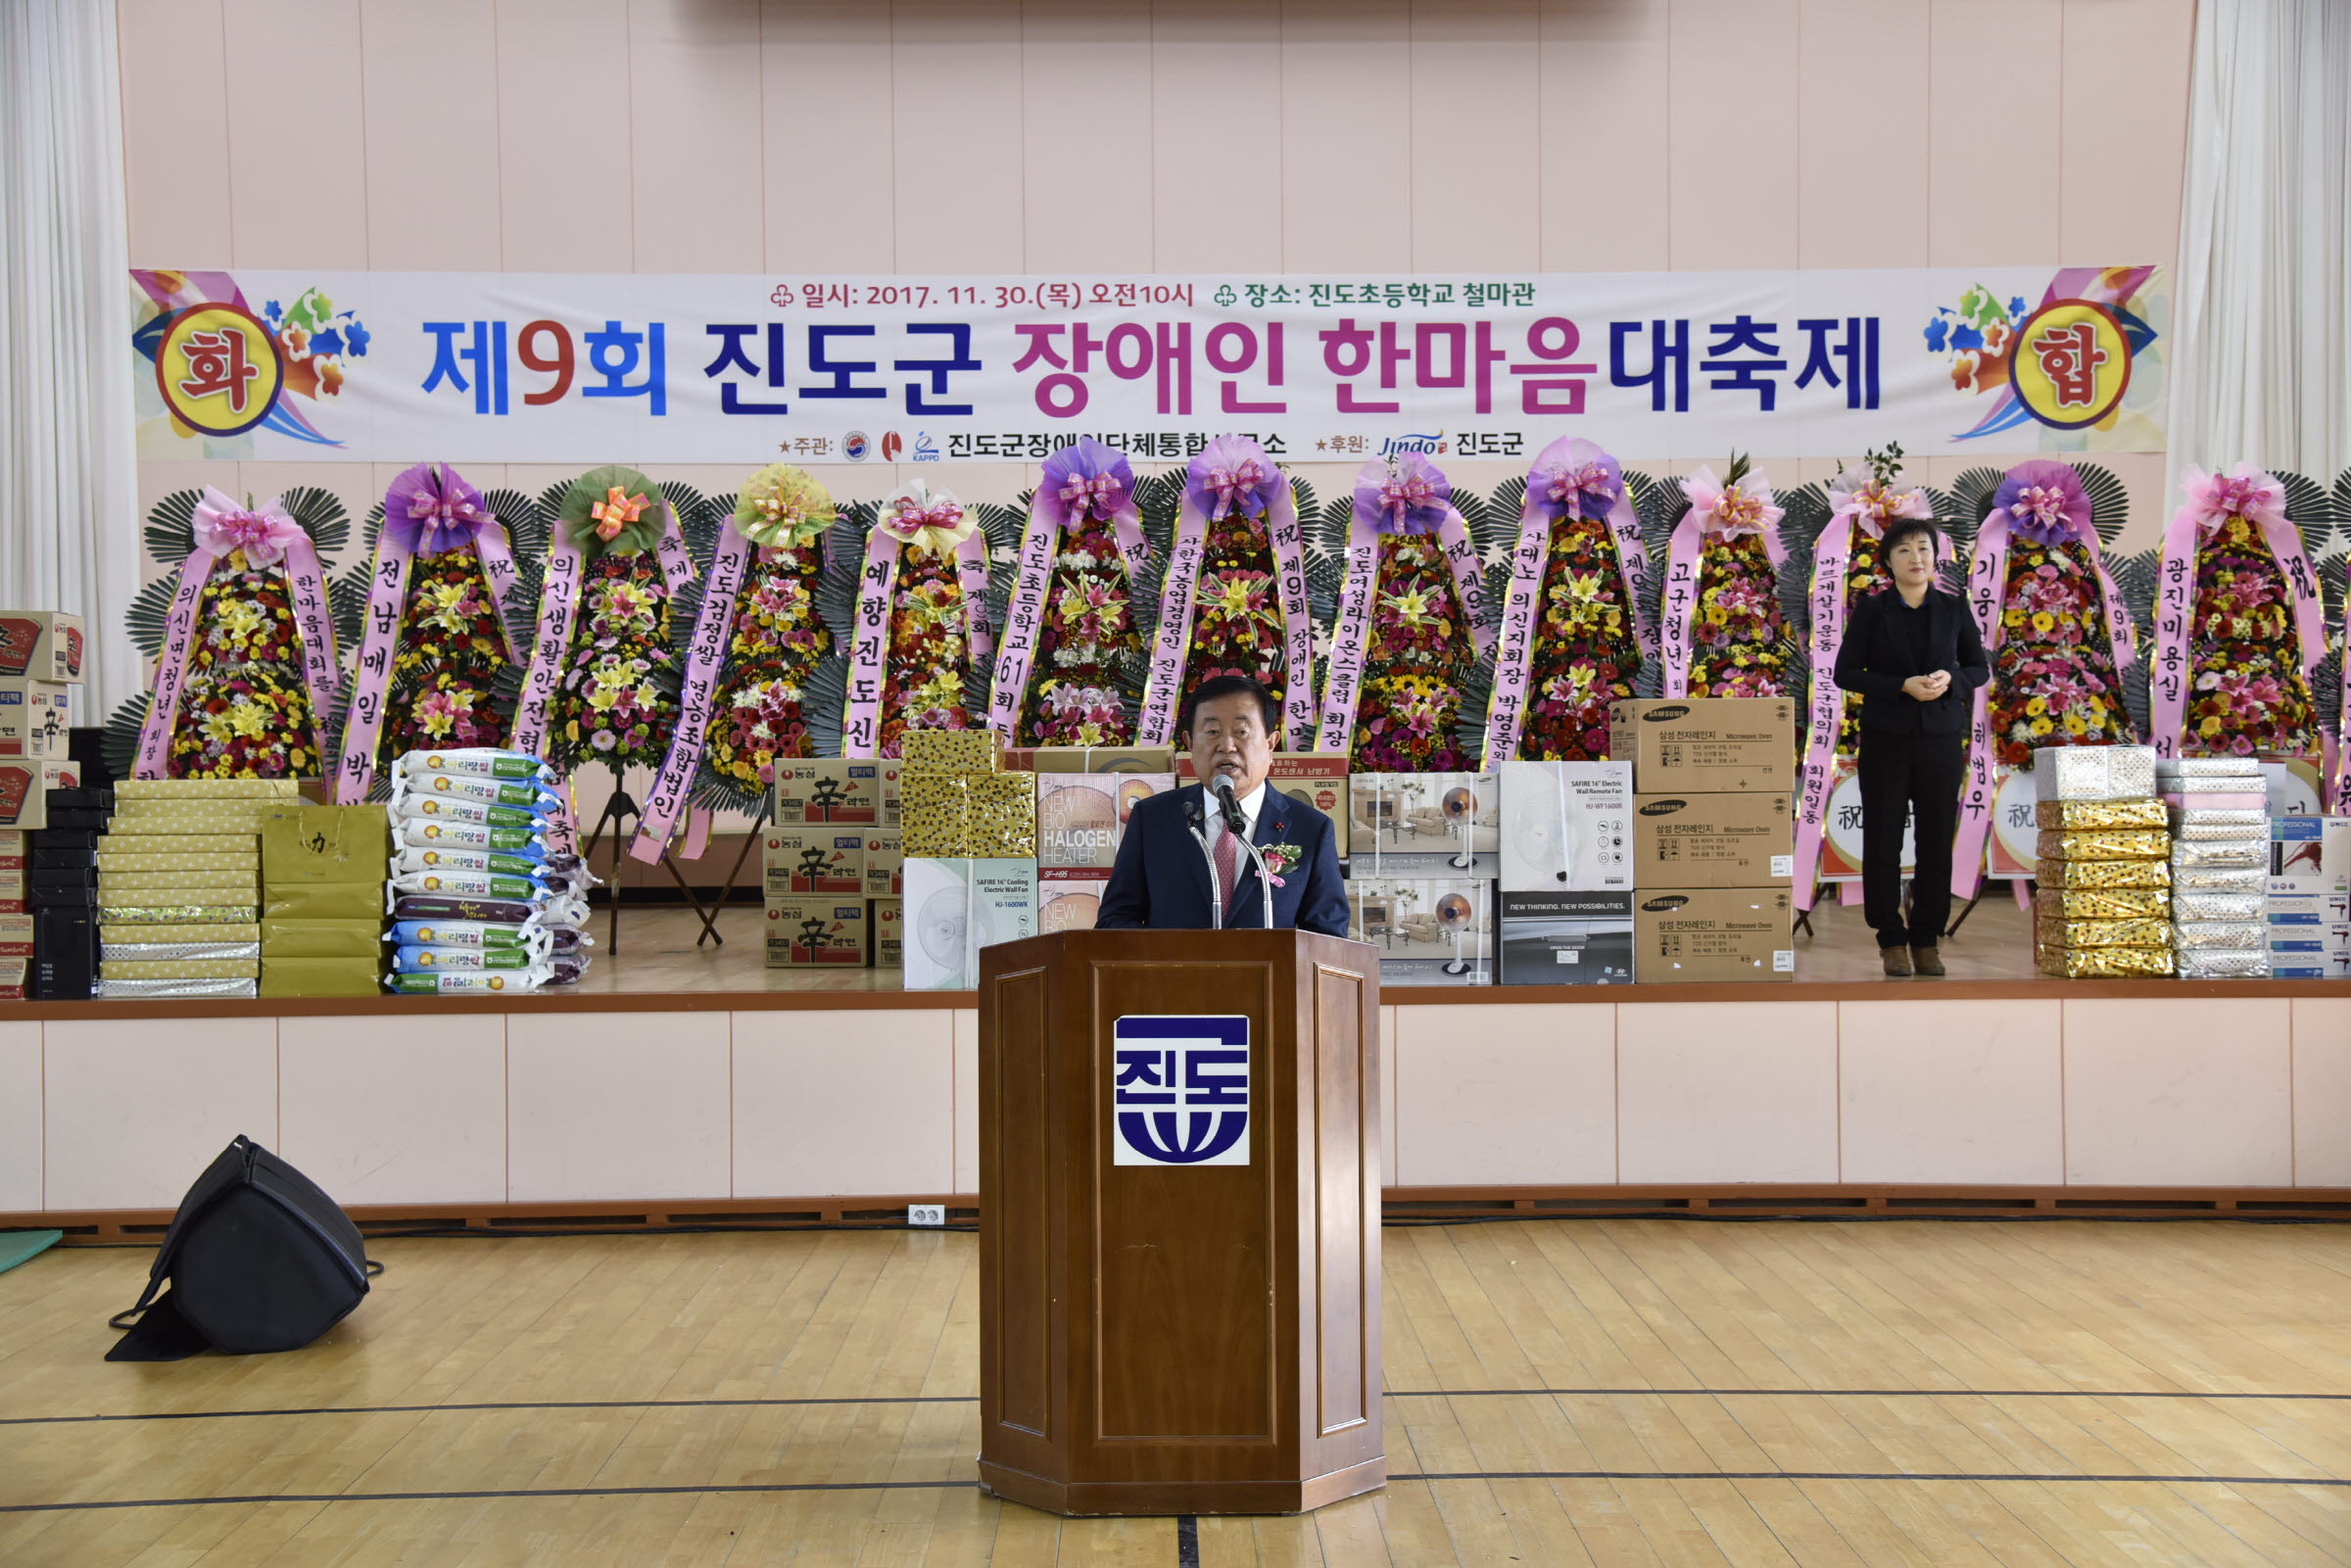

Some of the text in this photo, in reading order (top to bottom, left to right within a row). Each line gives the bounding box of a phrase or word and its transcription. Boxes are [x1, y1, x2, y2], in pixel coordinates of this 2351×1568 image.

[801, 284, 858, 309] 일시:
[866, 286, 938, 307] 2017.
[947, 286, 985, 306] 11.
[1089, 283, 1193, 309] 오전10시
[1244, 282, 1536, 309] 장소: 진도초등학교 철마관
[179, 328, 259, 412] 화
[421, 313, 1881, 419] 제9회 진도군 장애인 한마음 대축제
[2034, 323, 2108, 408] 합
[793, 437, 834, 455] 주관:
[1330, 435, 1369, 453] 후원:
[1457, 432, 1524, 455] 진도군
[1275, 524, 1300, 547] 祝
[1616, 524, 1642, 543] 祝
[1126, 543, 1150, 562] 祝
[1448, 540, 1473, 563] 祝
[489, 556, 515, 579] 祝
[1281, 556, 1306, 616] 제9회
[1973, 552, 1996, 639] 기웅
[694, 552, 739, 667] 진도검정쌀
[1814, 556, 1841, 652] 바르게살기운동
[1665, 562, 1691, 671] 고군청년
[2157, 557, 2188, 702] 광진미용실
[358, 557, 400, 724] 전남매일
[847, 560, 889, 758] 예향진도신
[1289, 628, 1310, 688] 장애인
[1320, 711, 1347, 747] 회장
[1659, 731, 1675, 740] 삼성
[1676, 731, 1716, 740] 전자레인지
[447, 760, 489, 773] 아리랑쌀
[794, 770, 815, 779] 농심
[453, 783, 496, 798] 아리랑쌀
[846, 797, 870, 807] 라면
[1043, 795, 1076, 813] NEW
[441, 803, 484, 821] 아리랑쌀
[1043, 813, 1066, 830] BIO
[1838, 804, 1863, 831] 祝
[2008, 803, 2036, 829] 祝
[443, 828, 486, 843] 아리랑쌀
[1656, 824, 1672, 833] 삼성
[1673, 824, 1713, 833] 전자레인지
[1043, 830, 1116, 847] HALOGEN
[442, 856, 484, 869] 아리랑쌀
[1043, 847, 1098, 864] HEATER
[833, 868, 857, 877] 라면
[443, 881, 486, 893] 아리랑쌀
[1044, 903, 1077, 920] NEW
[1658, 920, 1674, 929] 삼성
[1676, 920, 1715, 929] 전자레인지
[436, 931, 480, 944] 아리랑쌀
[833, 938, 857, 947] 라면
